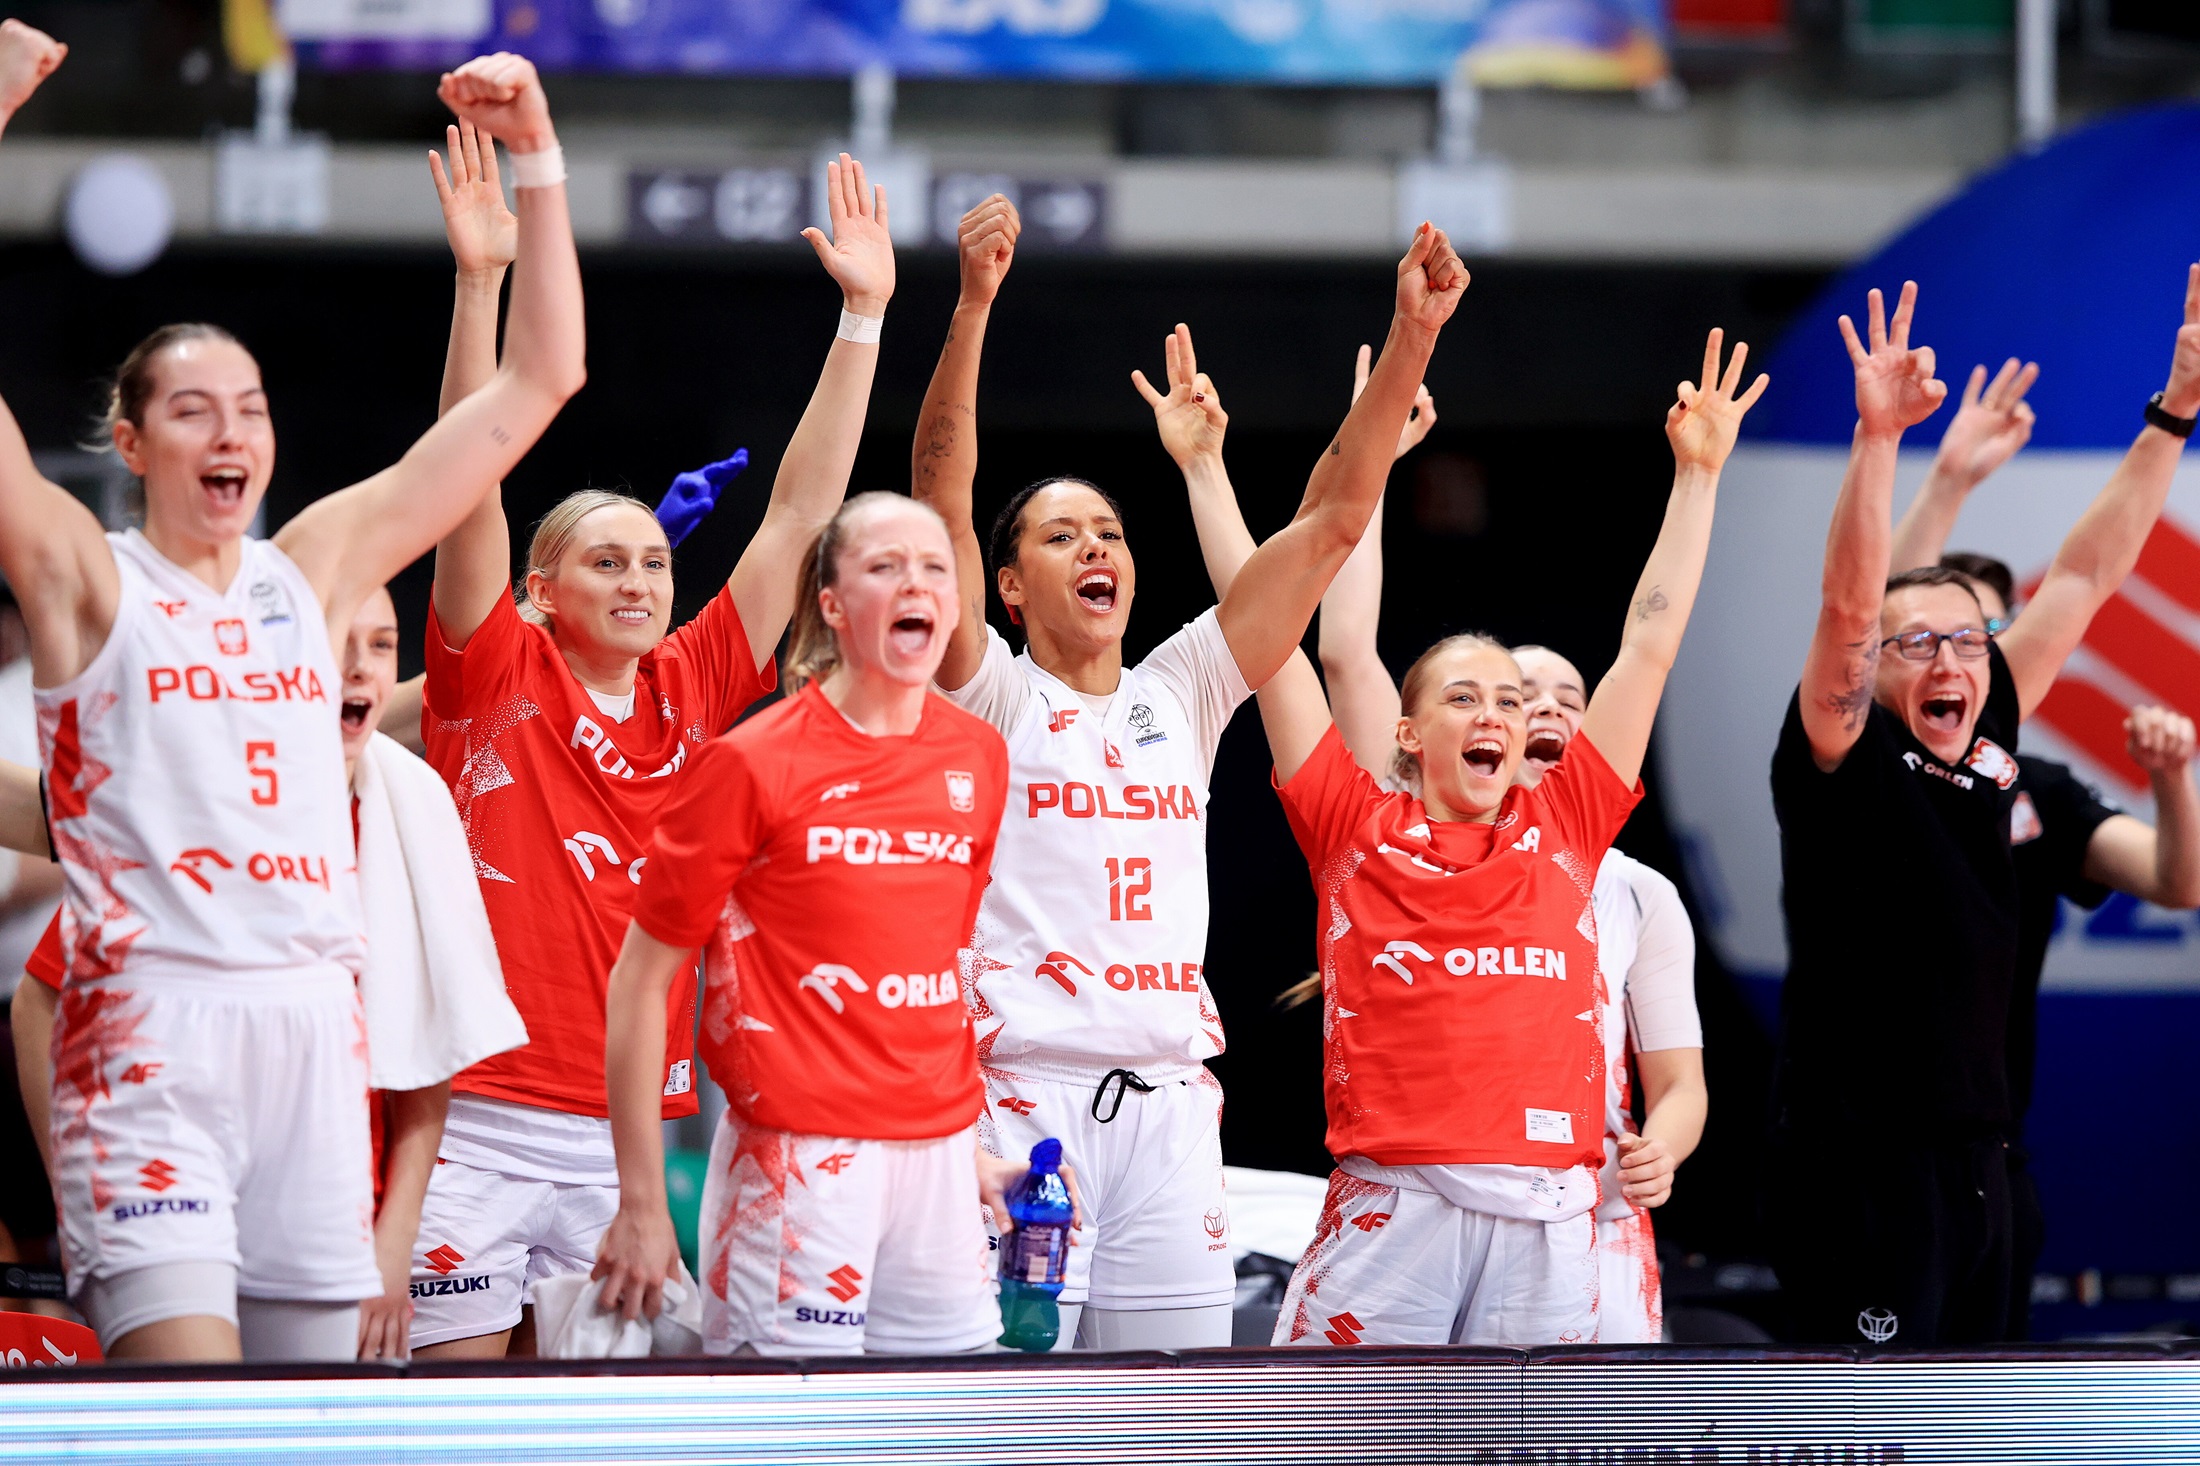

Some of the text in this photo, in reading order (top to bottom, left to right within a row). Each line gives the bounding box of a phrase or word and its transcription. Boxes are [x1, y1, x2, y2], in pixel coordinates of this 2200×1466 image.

[247, 741, 278, 805] 5
[1027, 782, 1198, 820] POLSKA
[807, 826, 974, 864] POLSKA
[1104, 857, 1152, 920] 12
[1105, 962, 1204, 992] ORLE
[1443, 946, 1566, 980] ORLEN
[1351, 1211, 1392, 1232] 4F
